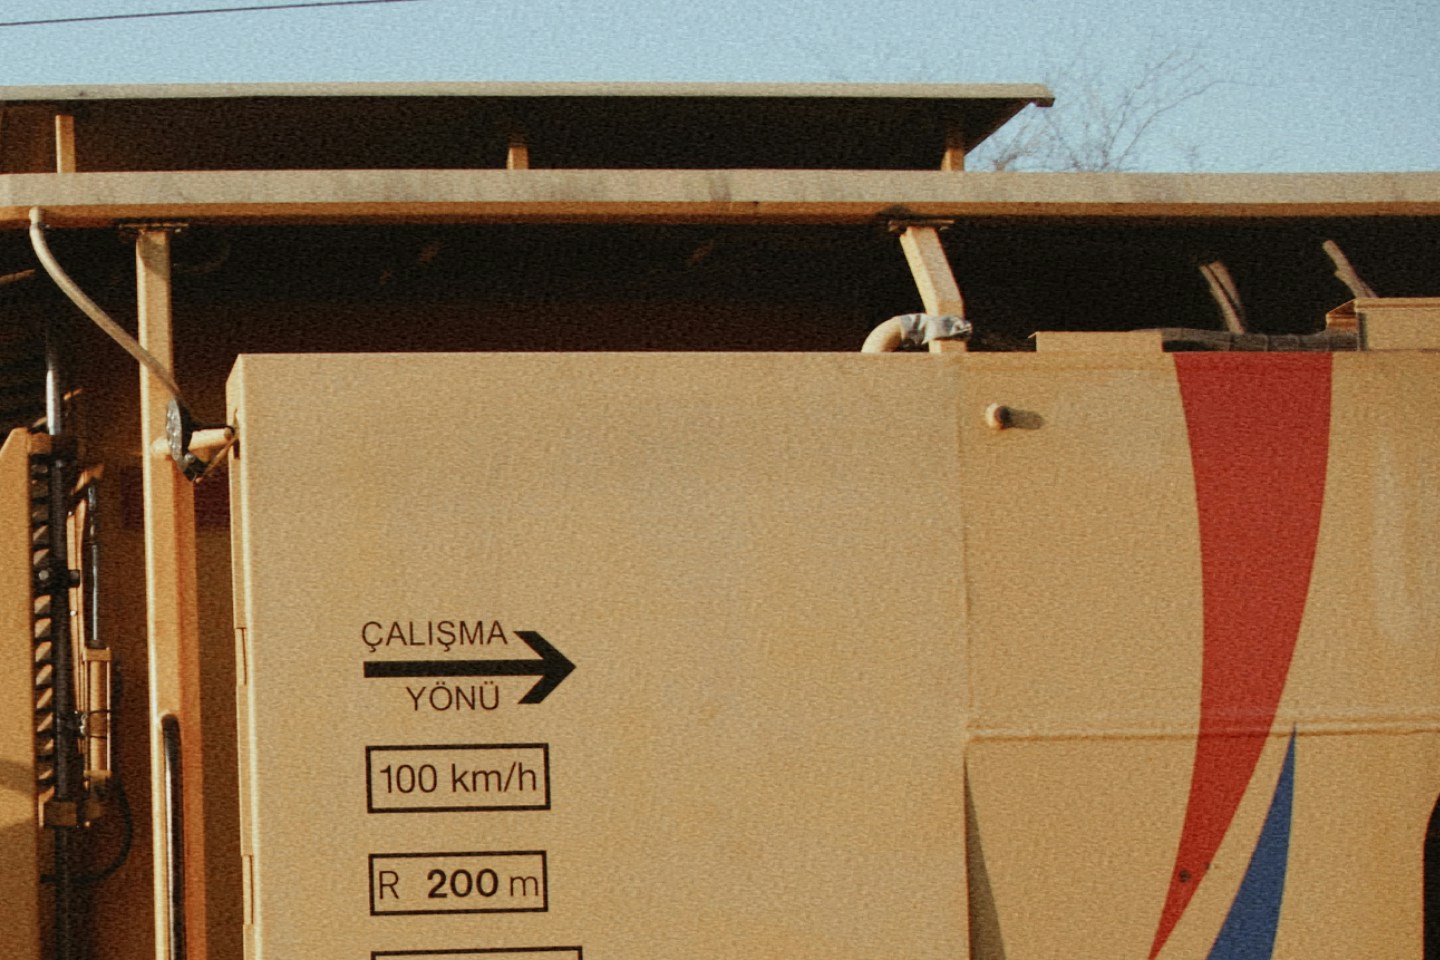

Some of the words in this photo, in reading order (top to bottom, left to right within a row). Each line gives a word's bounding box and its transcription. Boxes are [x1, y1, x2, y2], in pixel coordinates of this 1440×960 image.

[362, 620, 509, 653] ÇALIŞMA
[406, 681, 500, 712] YÖNÜ
[380, 764, 438, 794] 100
[452, 762, 537, 793] km/h
[379, 871, 400, 900] R
[428, 868, 500, 899] 200
[510, 876, 539, 897] m
